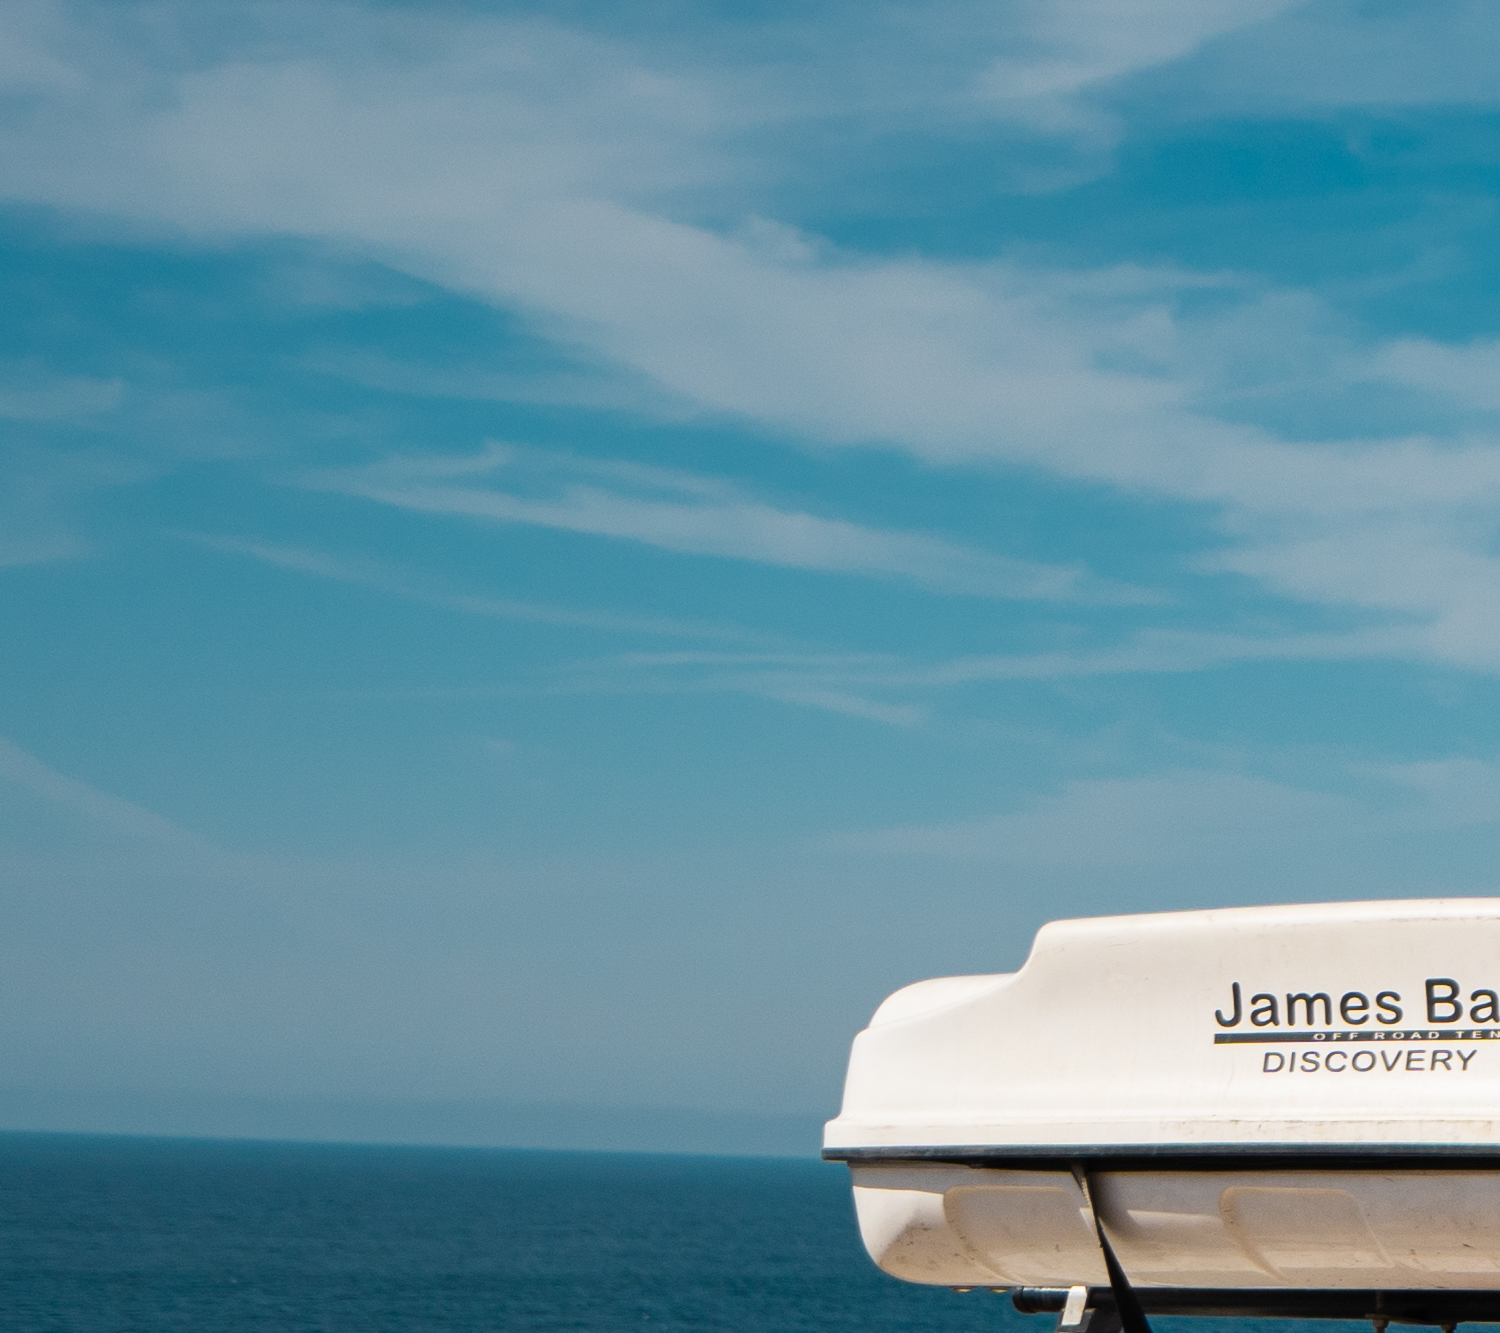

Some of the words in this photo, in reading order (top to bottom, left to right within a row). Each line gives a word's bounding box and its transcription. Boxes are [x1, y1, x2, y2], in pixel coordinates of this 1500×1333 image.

[1214, 981, 1403, 1028] James
[1313, 1031, 1360, 1042] OFF
[1374, 1030, 1442, 1041] ROAD
[1262, 1048, 1478, 1074] DISCOVERY
